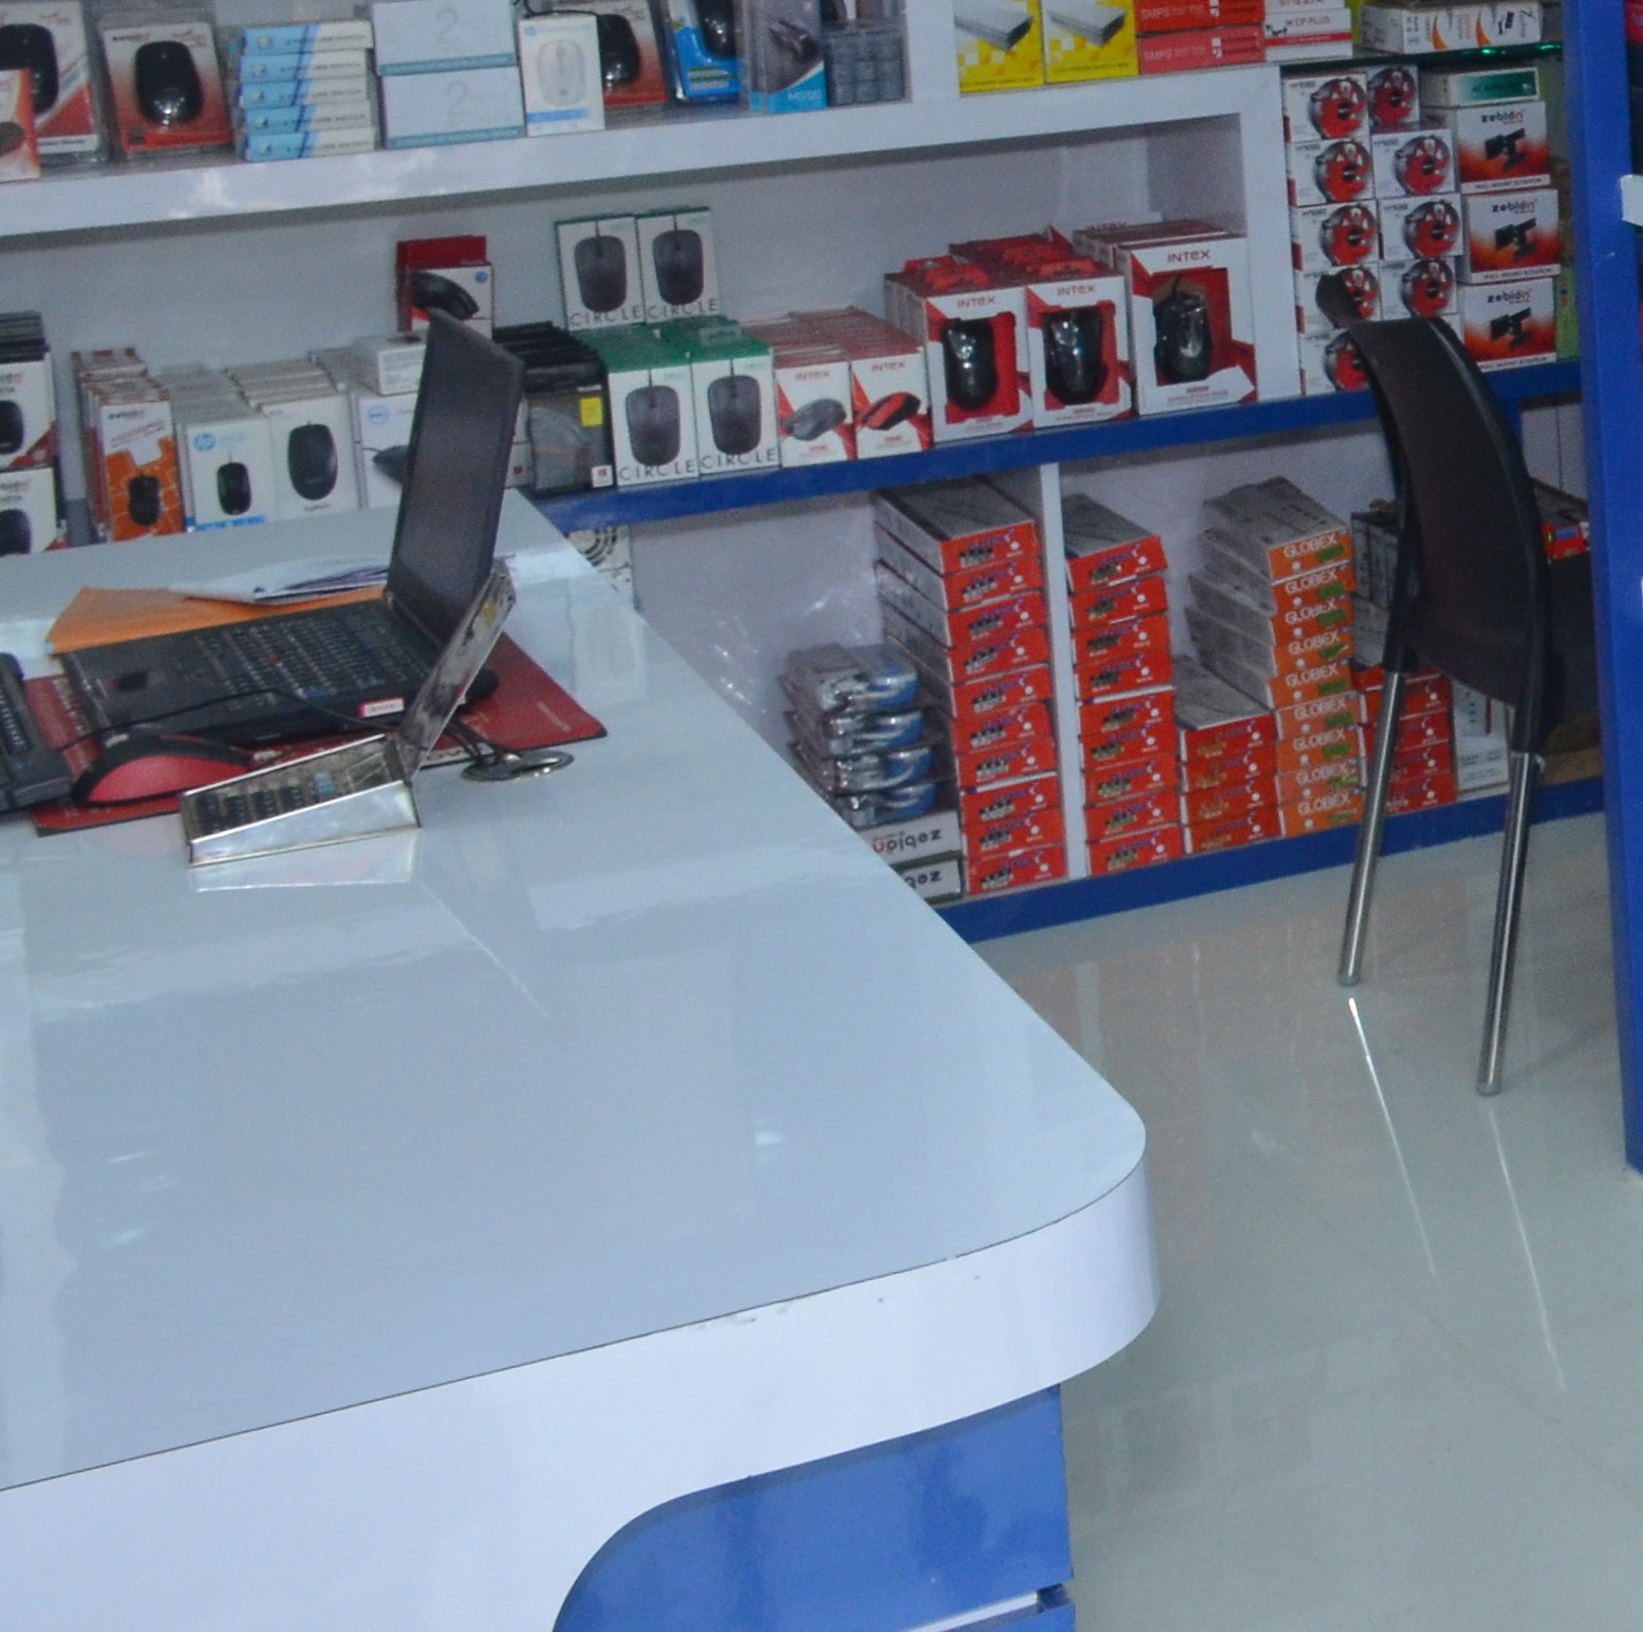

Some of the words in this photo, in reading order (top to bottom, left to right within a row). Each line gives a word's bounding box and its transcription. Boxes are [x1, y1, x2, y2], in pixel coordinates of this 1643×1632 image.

[571, 306, 644, 327] CIRCLE
[649, 298, 718, 322] CIRCLE
[620, 459, 694, 481] CIRCLE
[703, 449, 775, 469] CIRCLE
[1284, 534, 1337, 559] GLOBEX
[1285, 571, 1337, 594] GLOBEX
[1294, 698, 1347, 720] GLOBEX
[1298, 794, 1350, 816] GLOBEX
